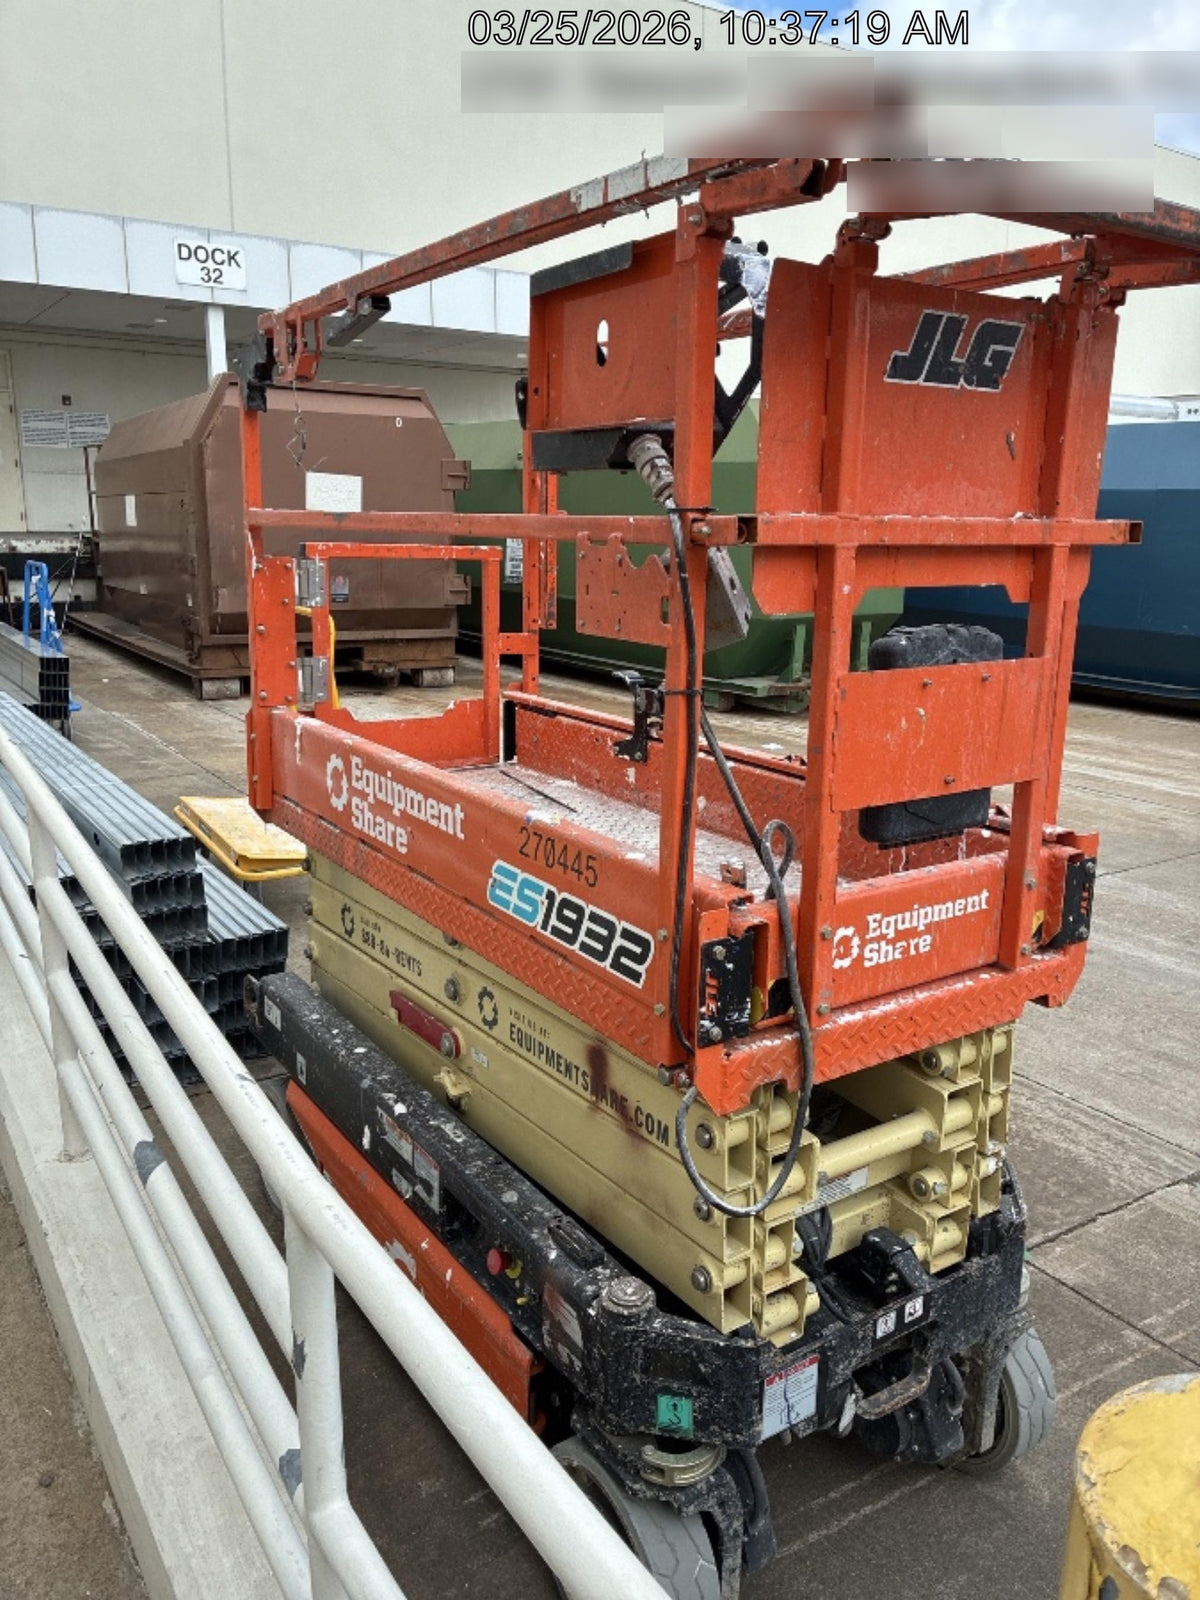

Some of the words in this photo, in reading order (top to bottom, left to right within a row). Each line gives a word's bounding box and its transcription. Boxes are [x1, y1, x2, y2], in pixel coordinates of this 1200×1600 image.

[177, 242, 242, 269] DOCK
[200, 266, 224, 285] 32
[883, 309, 1026, 392] JLG
[350, 754, 465, 841] Equipment
[351, 796, 408, 855] Share
[518, 826, 598, 888] 270445
[487, 859, 655, 989] ES1932
[865, 888, 989, 939] Equipment
[863, 933, 933, 968] Share
[509, 1021, 670, 1147] EQUIPMENTSARE.COM
